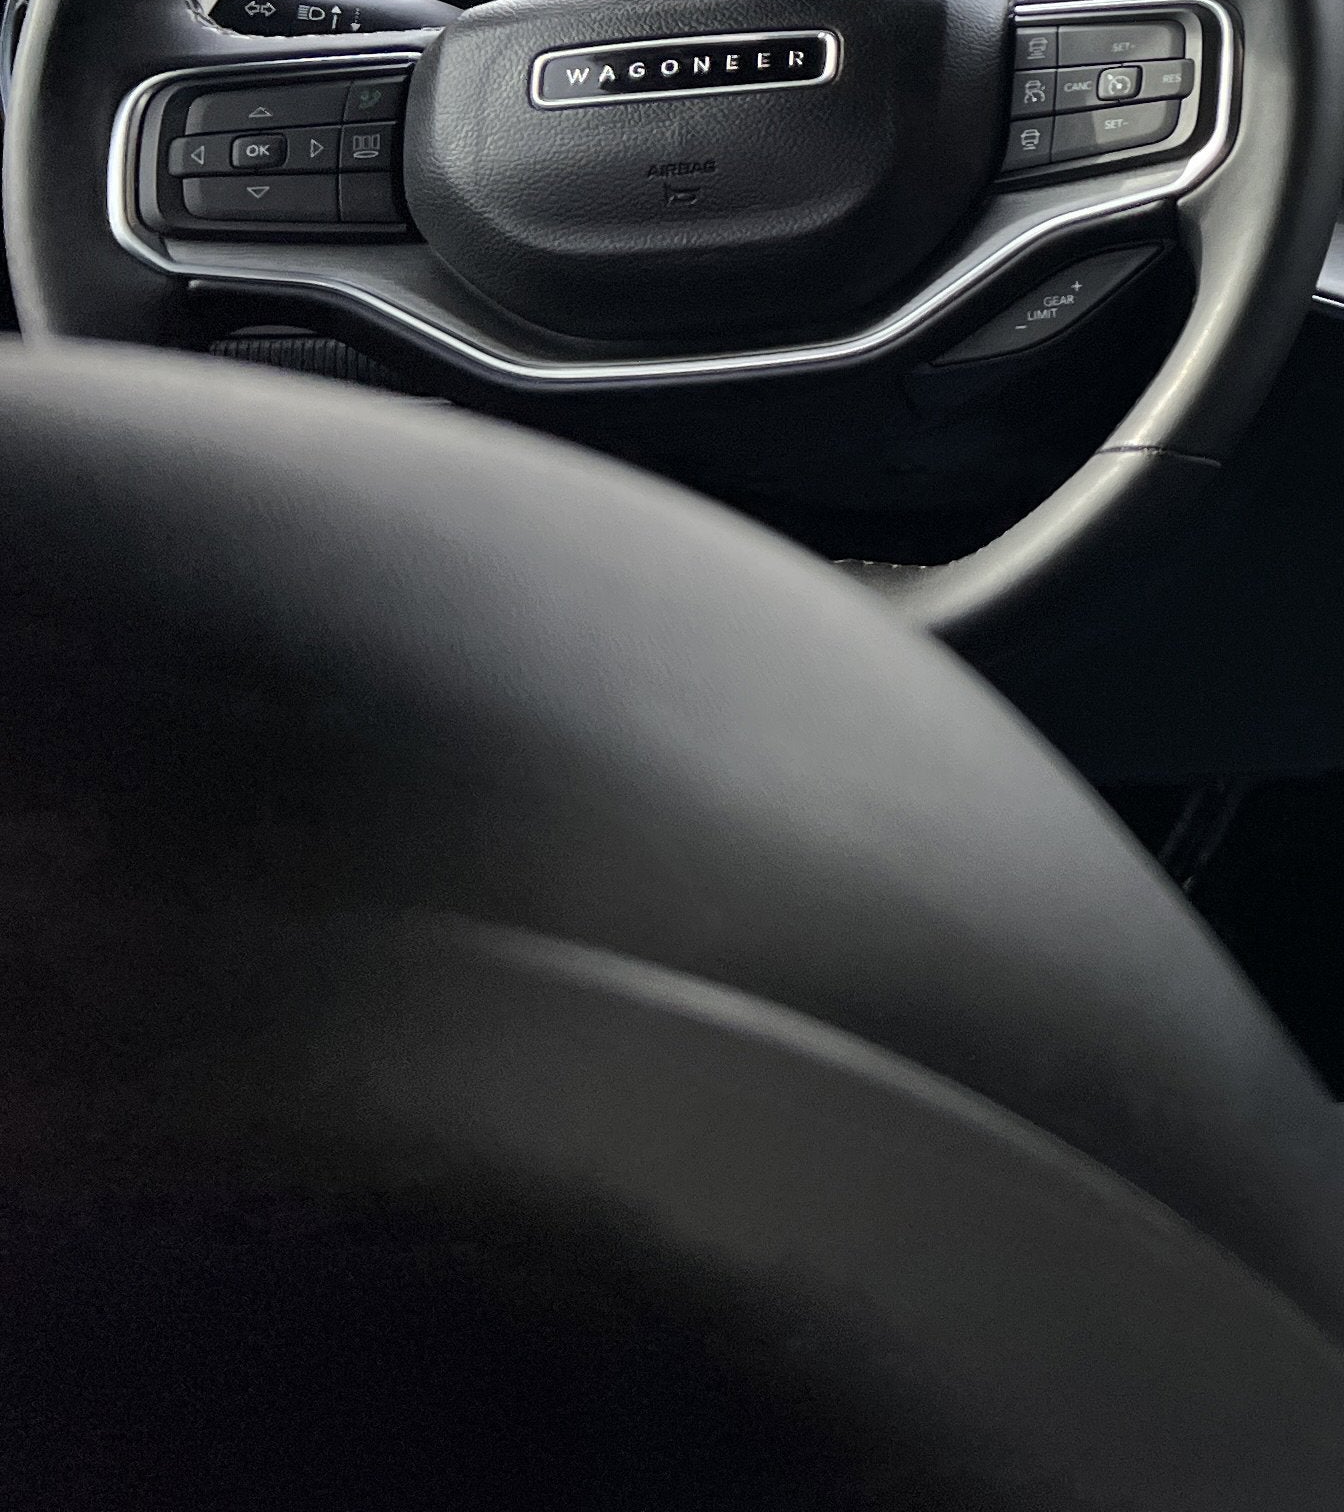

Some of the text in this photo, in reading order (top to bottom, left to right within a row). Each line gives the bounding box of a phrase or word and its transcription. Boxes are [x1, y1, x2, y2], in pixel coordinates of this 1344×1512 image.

[565, 50, 805, 86] WAGONEER
[1162, 73, 1182, 84] RES
[1063, 80, 1093, 92] CANC
[244, 142, 271, 158] OK
[646, 160, 717, 179] AIRBAG
[1043, 295, 1075, 307] GEAR
[1027, 308, 1058, 321] LIMIT
